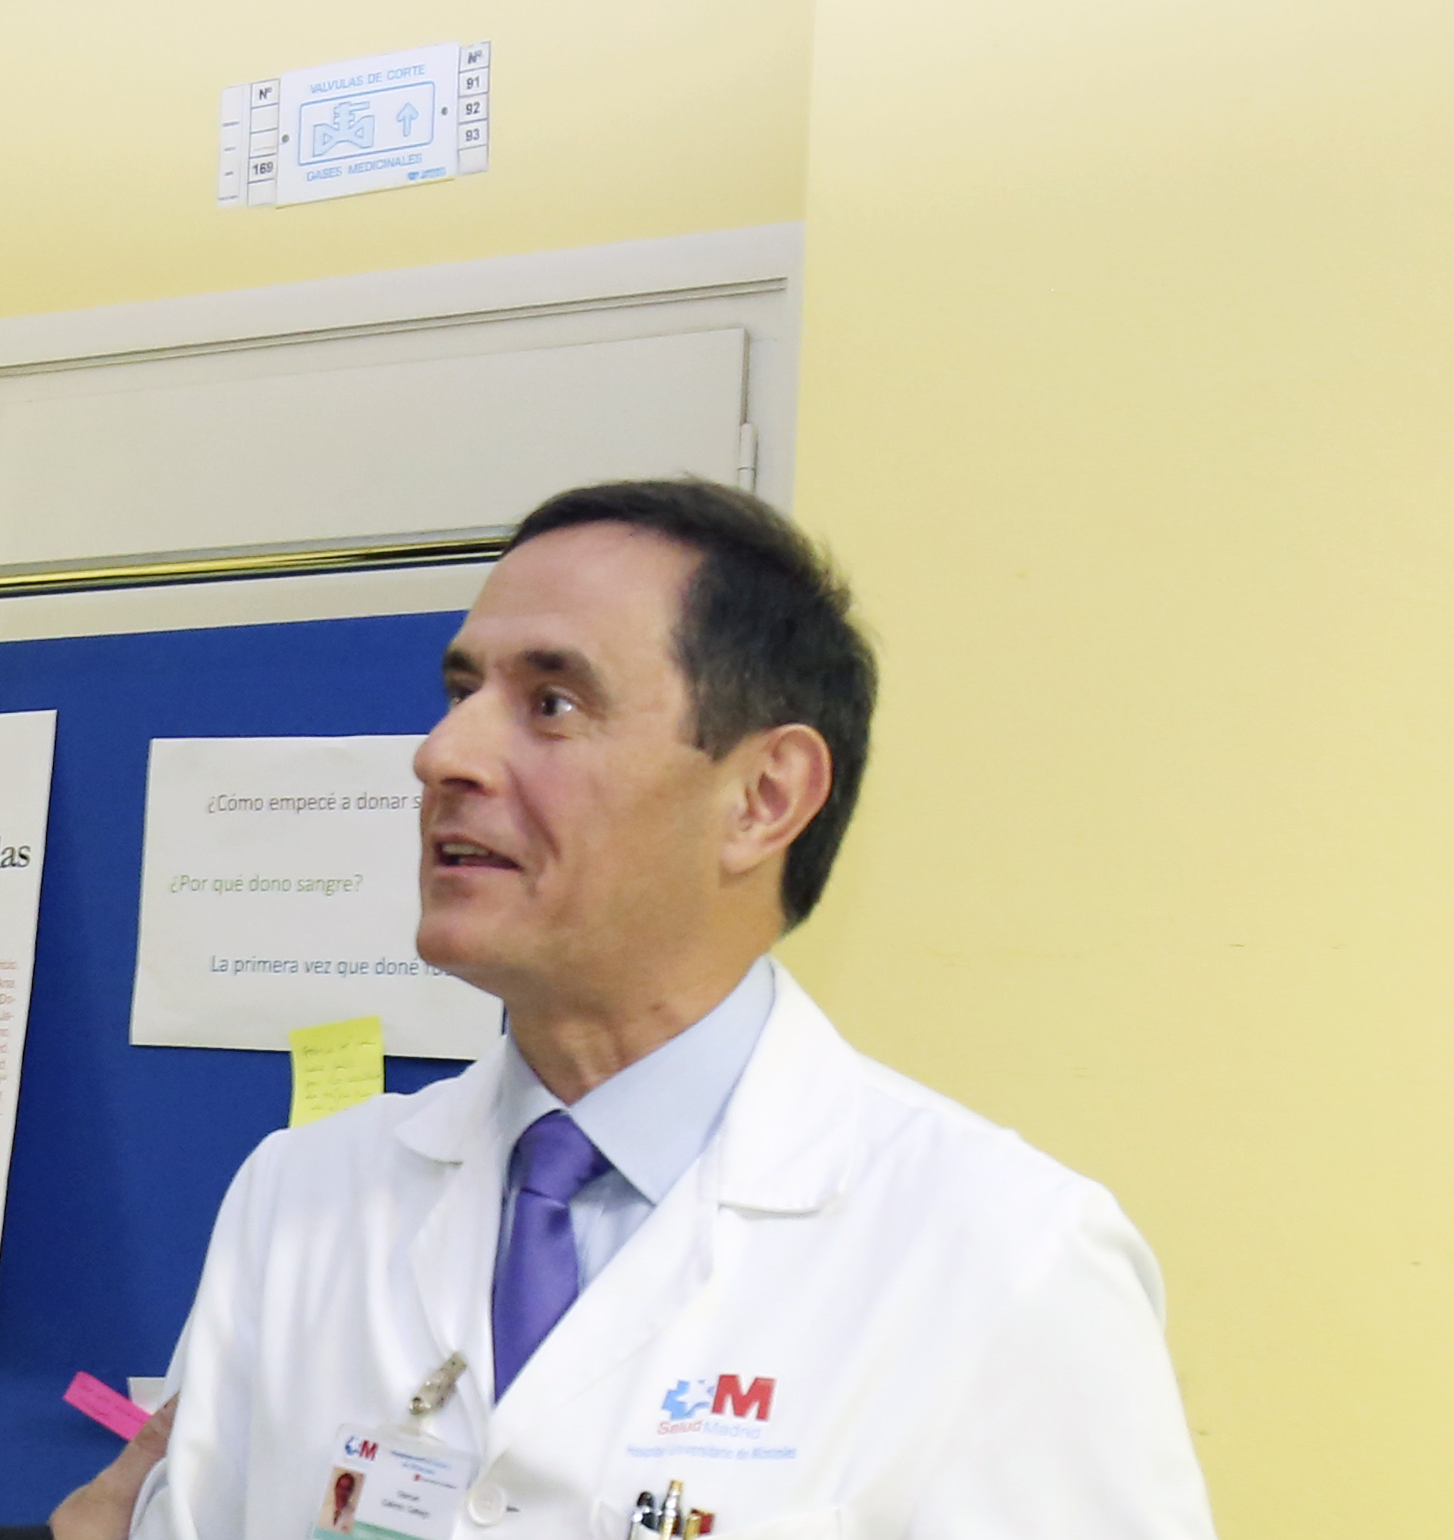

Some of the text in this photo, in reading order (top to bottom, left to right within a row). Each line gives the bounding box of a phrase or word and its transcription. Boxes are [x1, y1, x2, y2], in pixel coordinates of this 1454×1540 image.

[310, 63, 426, 94] VALVULAS DE CORTE
[466, 76, 480, 90] 91
[465, 101, 481, 115] 92
[465, 128, 480, 142] 93
[252, 161, 274, 175] 169
[306, 167, 343, 183] GASES
[347, 153, 423, 175] MEDICINALES
[207, 793, 264, 815] ¿Cómo
[269, 792, 336, 815] empecé
[342, 797, 351, 811] a
[357, 792, 410, 811] donar
[170, 873, 363, 896] ¿Por qué dono sangre?
[209, 955, 229, 973] La
[234, 955, 299, 976] primera
[304, 959, 331, 974] vez
[338, 960, 367, 978] que
[375, 956, 419, 975] doné
[711, 1373, 777, 1422] M
